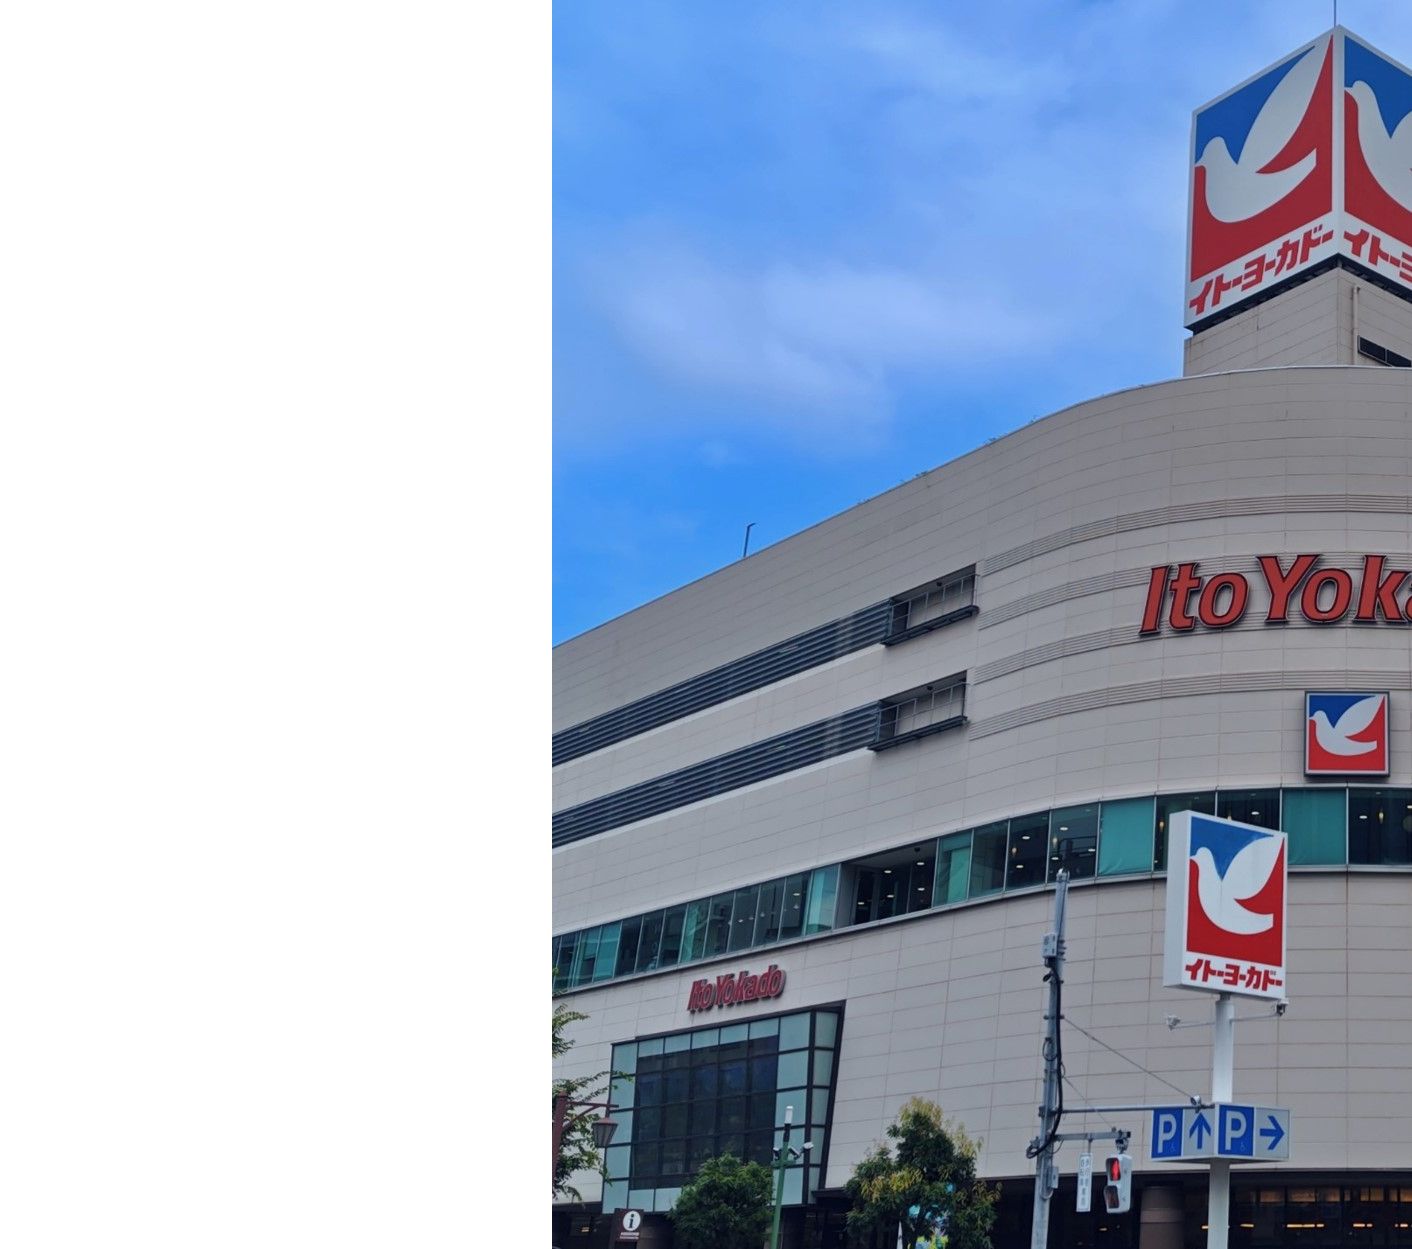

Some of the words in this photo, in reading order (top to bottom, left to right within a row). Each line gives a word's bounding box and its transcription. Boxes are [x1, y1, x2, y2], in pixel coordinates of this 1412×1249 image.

[1189, 224, 1334, 315] イトーヨーカドー
[1139, 562, 1249, 635] Ito
[687, 979, 716, 1012] Ito
[715, 964, 786, 1007] Yokado
[1185, 958, 1283, 992] イトーヨーカドー
[1157, 1113, 1177, 1154] P
[1224, 1110, 1247, 1150] P
